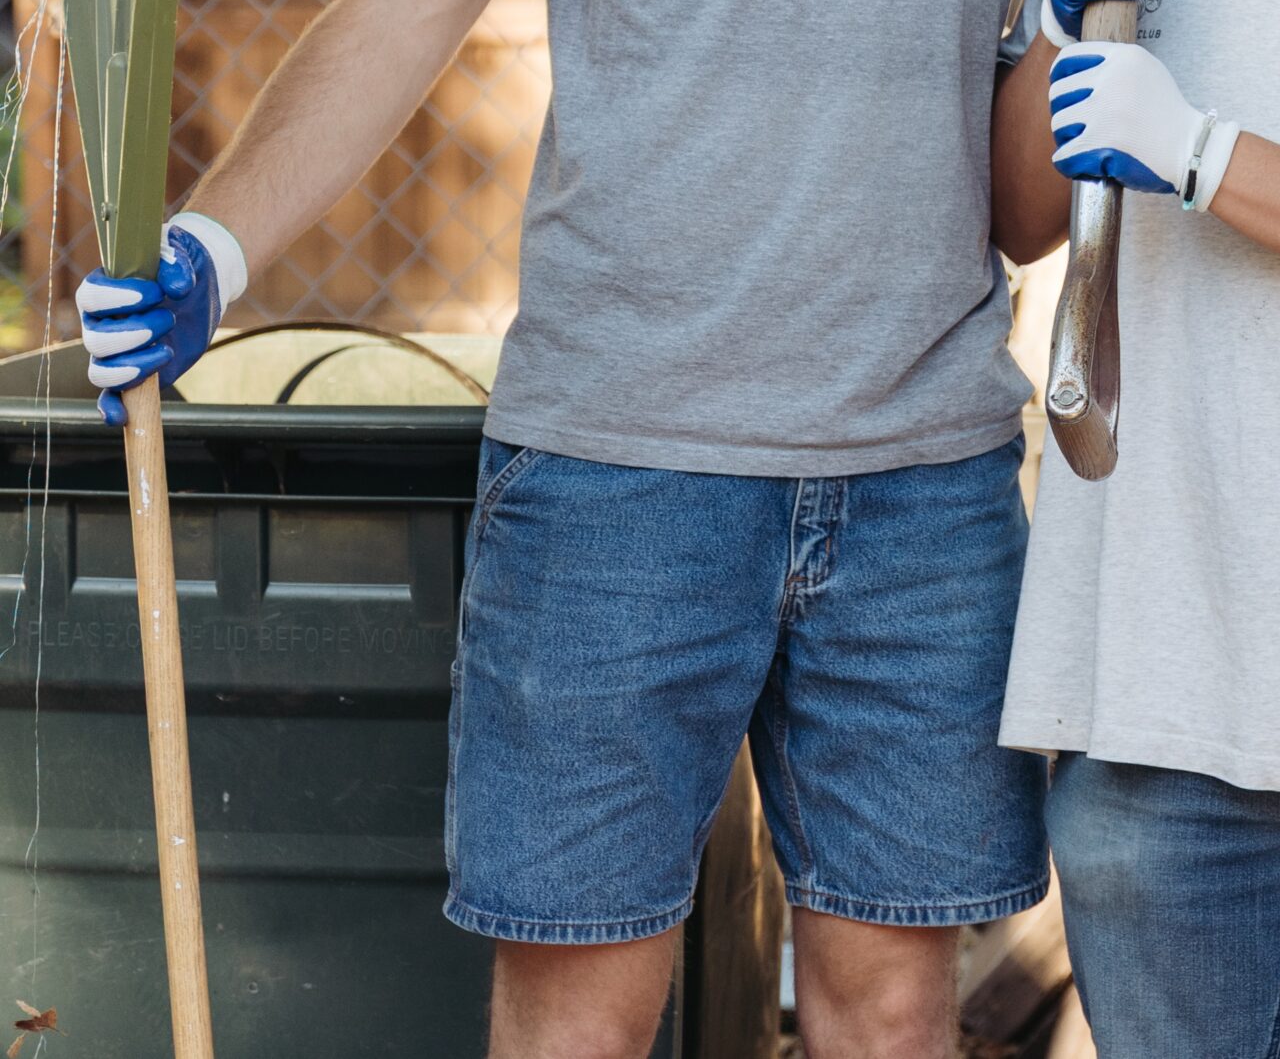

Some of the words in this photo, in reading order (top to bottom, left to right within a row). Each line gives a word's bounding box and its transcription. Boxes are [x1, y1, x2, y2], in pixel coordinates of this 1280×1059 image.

[1136, 29, 1162, 40] CLUB
[28, 621, 117, 648] PLEASE
[213, 625, 248, 651] LID
[259, 626, 352, 654] BEFORE
